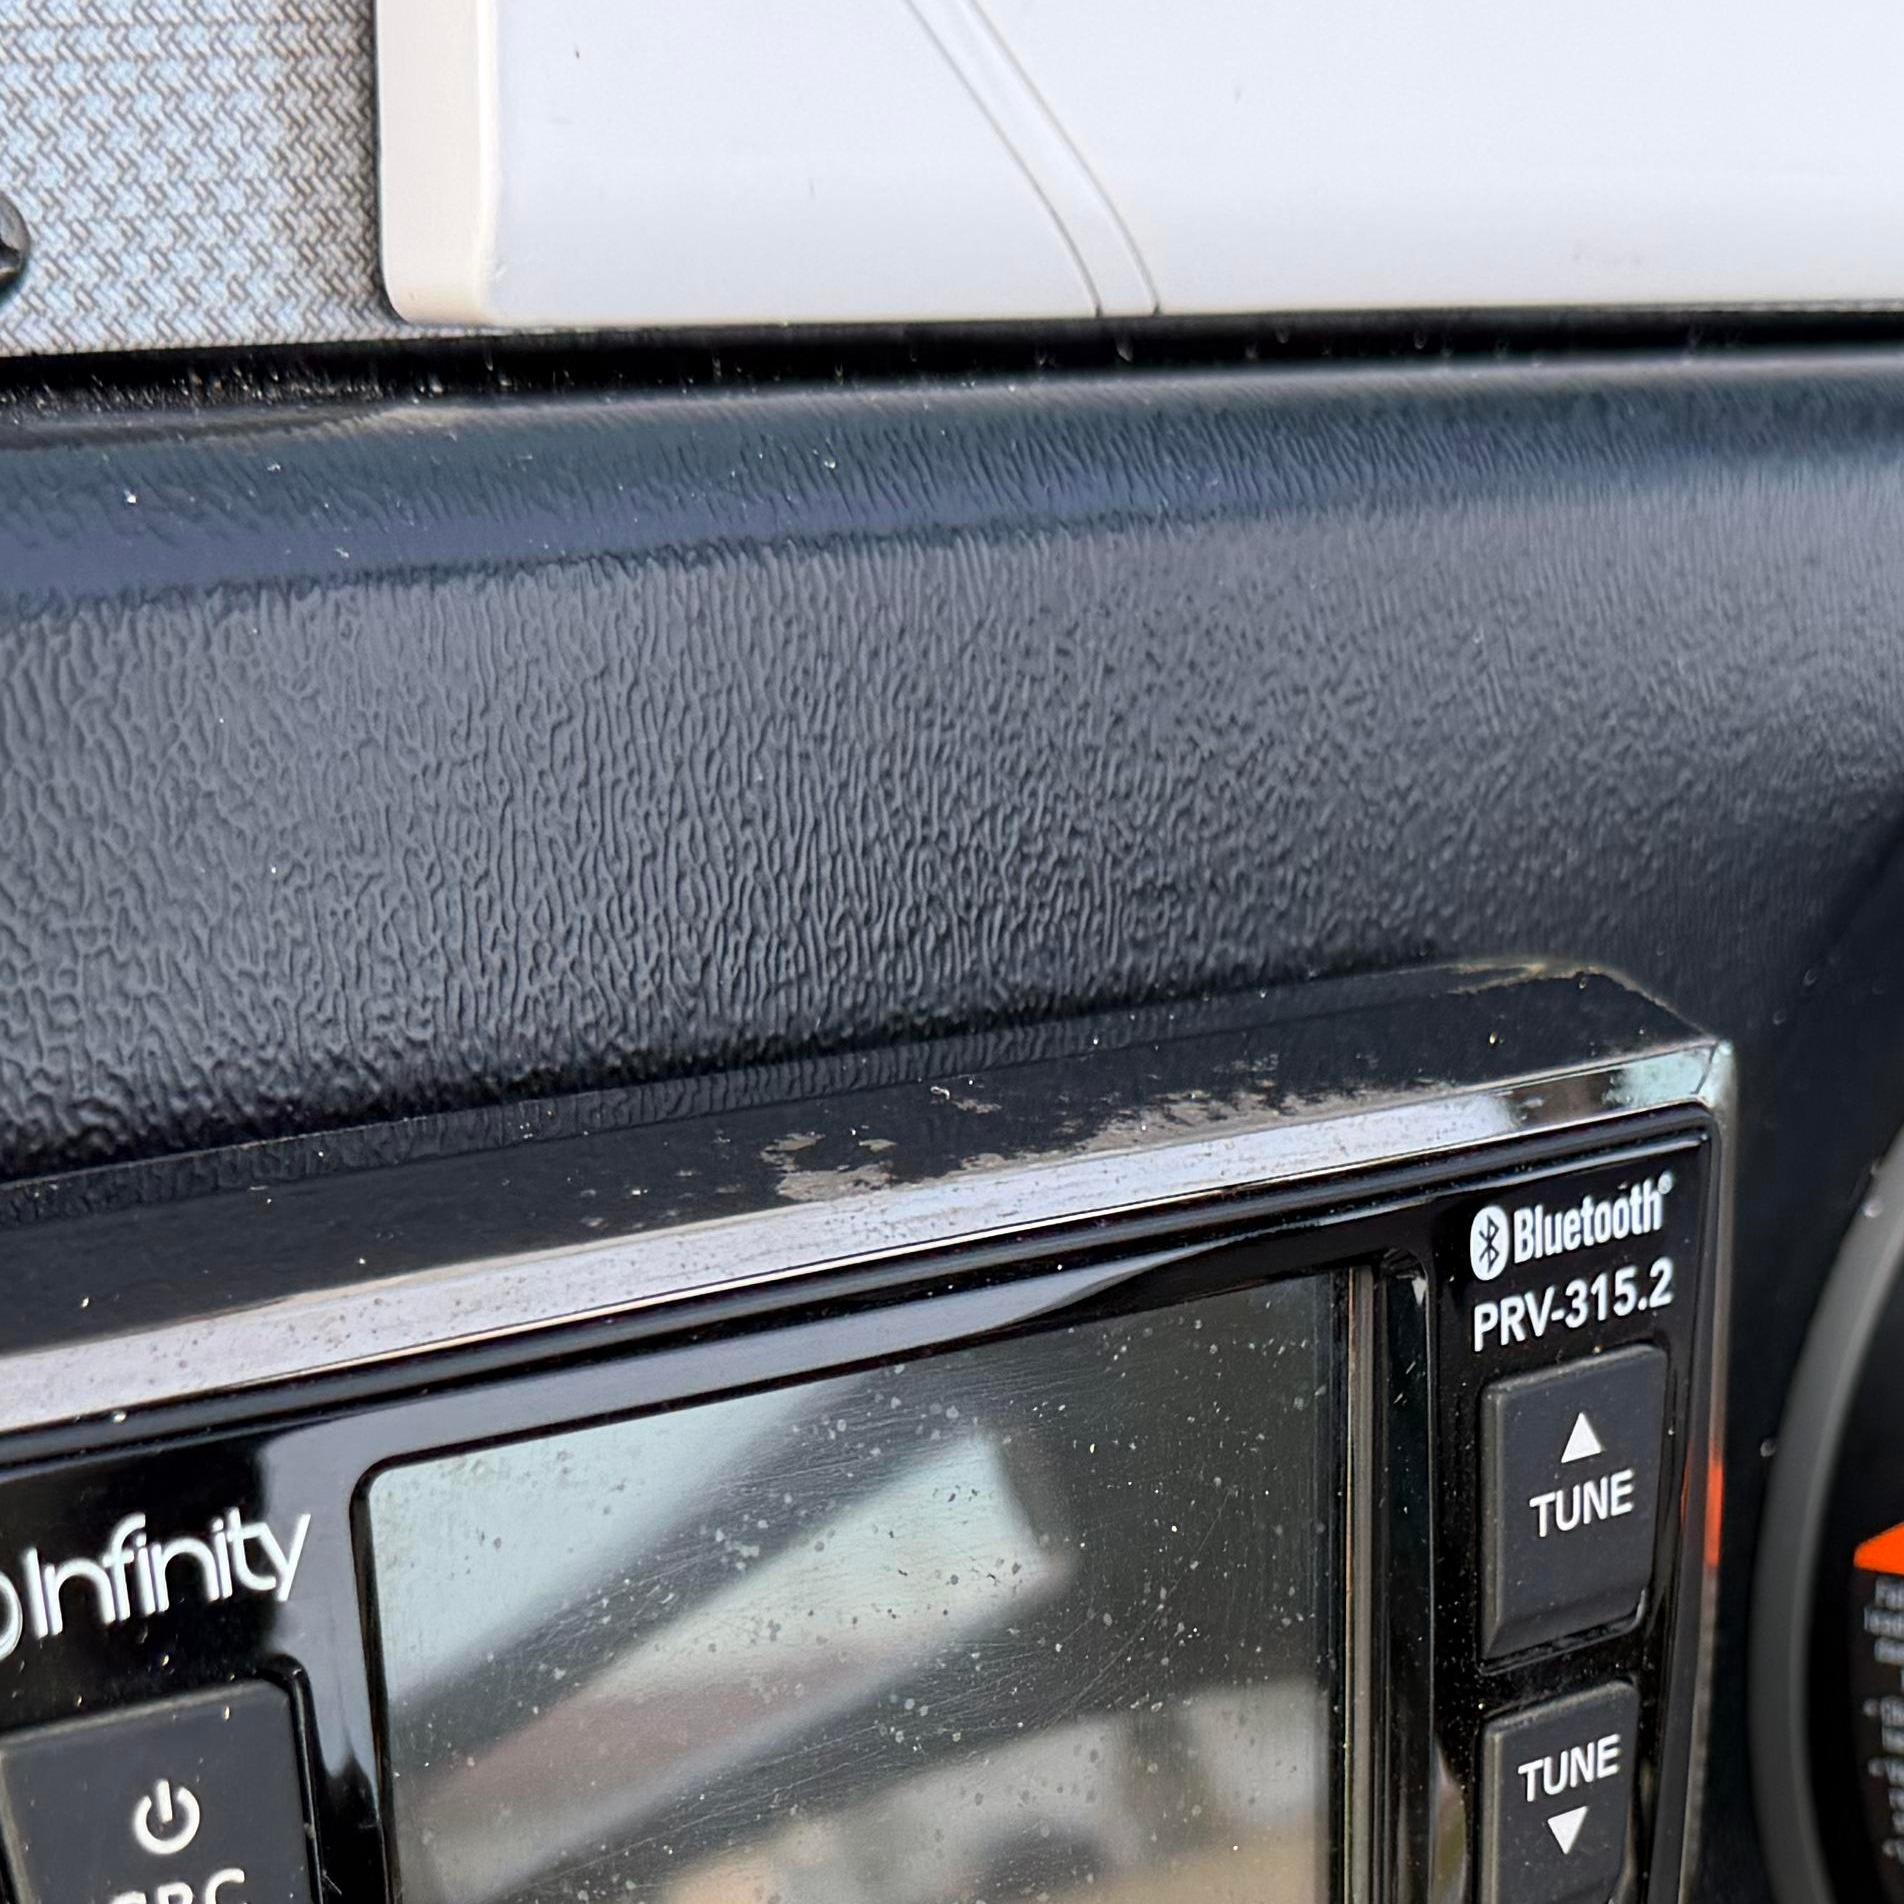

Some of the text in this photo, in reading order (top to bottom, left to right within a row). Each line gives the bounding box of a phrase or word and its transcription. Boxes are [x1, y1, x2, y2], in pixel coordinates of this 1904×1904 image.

[1473, 1256, 1674, 1352] PRV-315.2
[1529, 1468, 1635, 1537] TUNE
[23, 1506, 312, 1639] Infinity
[1517, 1733, 1621, 1802] TUNE
